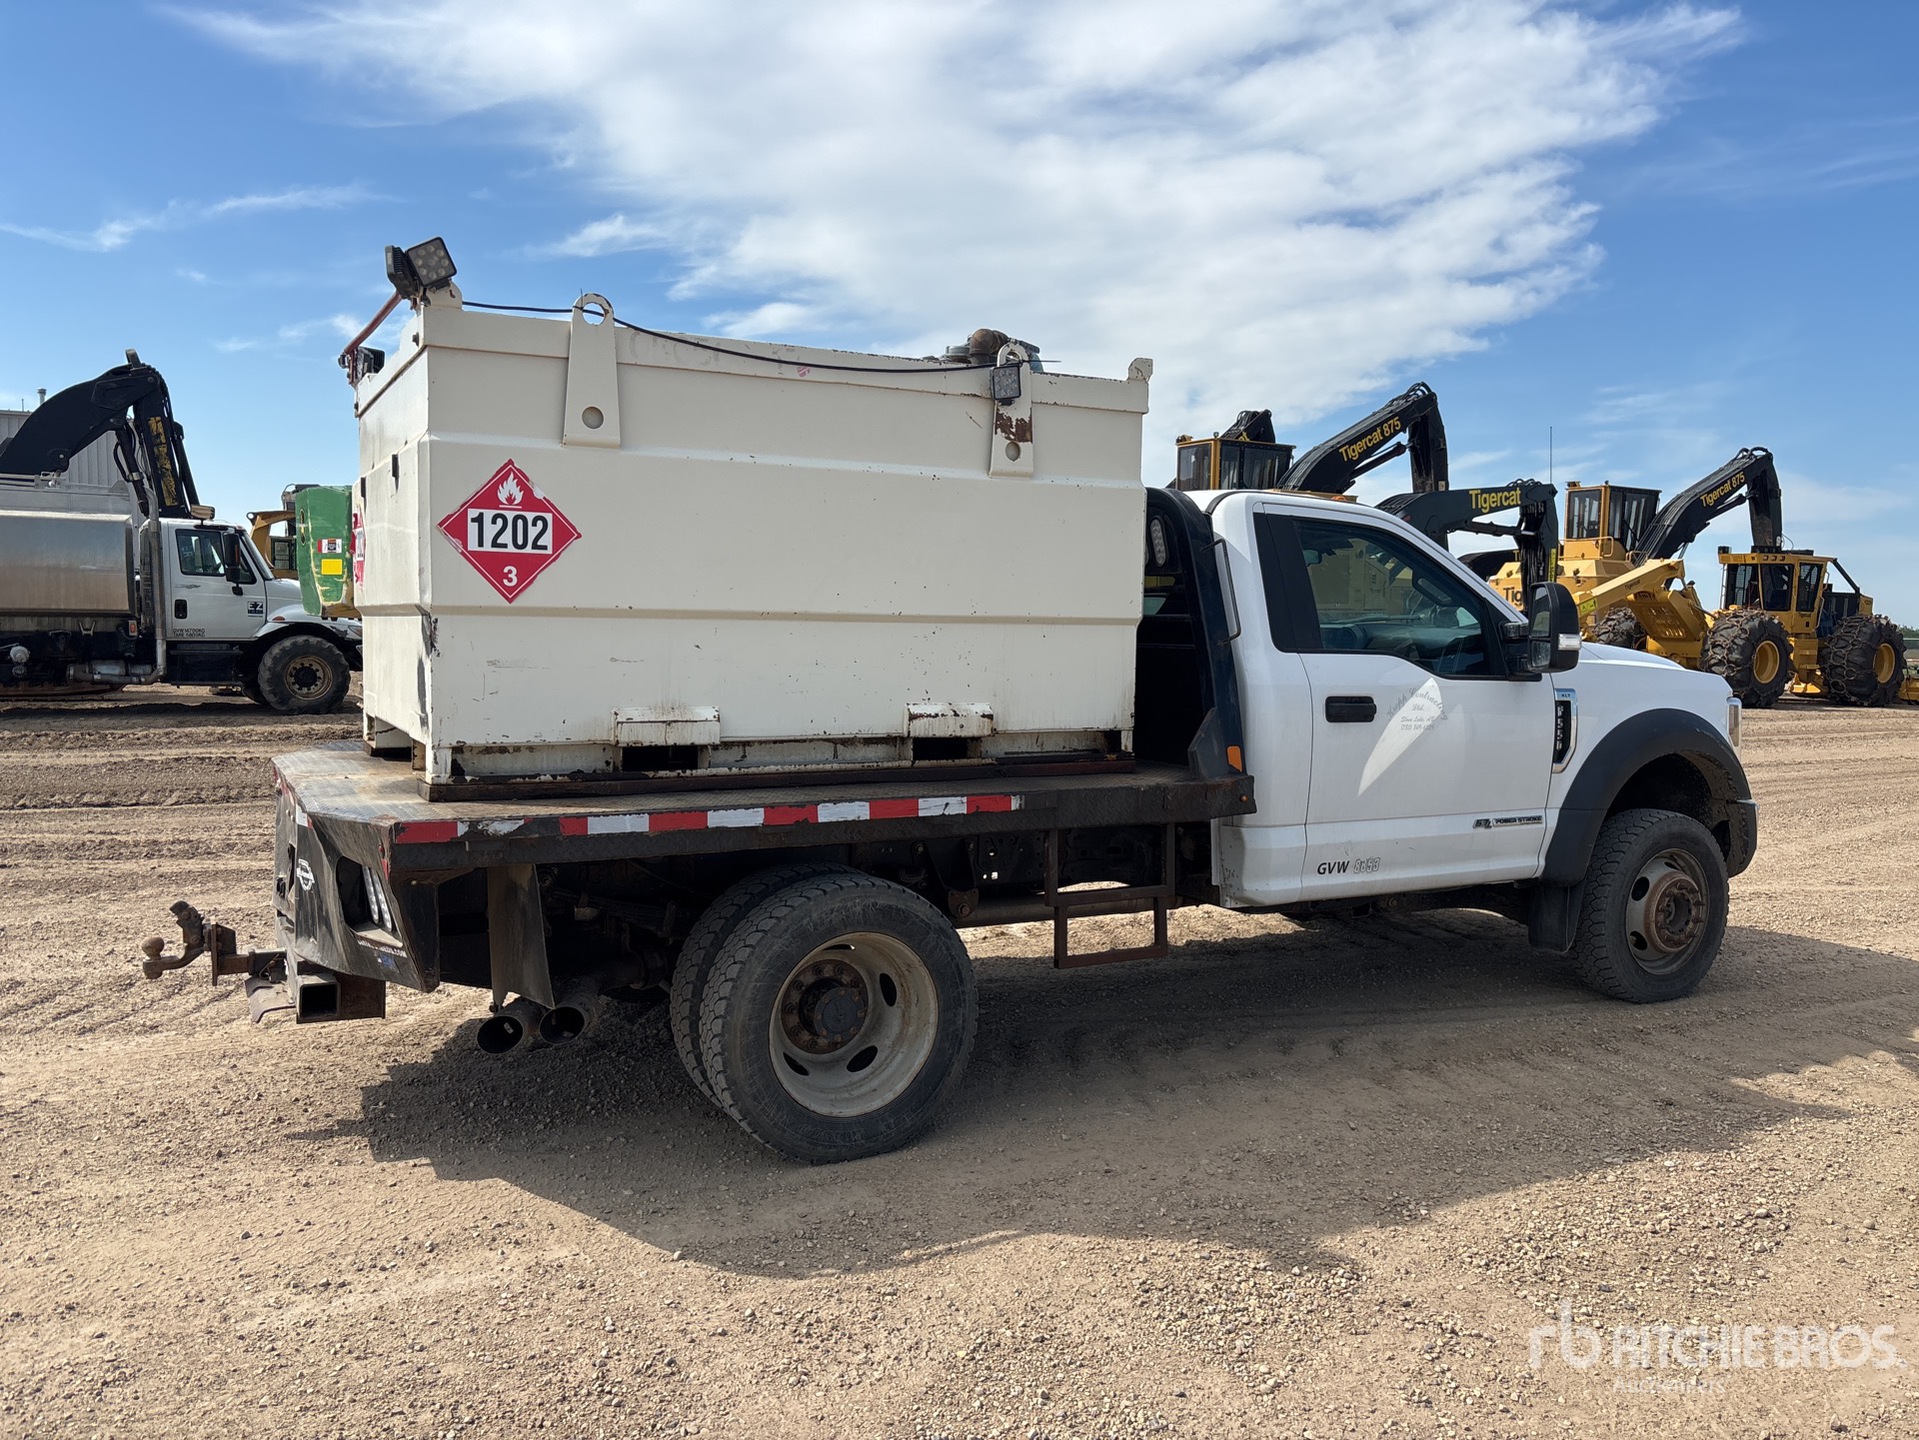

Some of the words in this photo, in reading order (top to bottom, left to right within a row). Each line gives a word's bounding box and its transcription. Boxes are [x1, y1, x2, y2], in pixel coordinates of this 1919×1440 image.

[1339, 427, 1383, 461] Tigercat
[1383, 417, 1401, 437] 875
[1469, 488, 1521, 513] Tigercat
[1700, 480, 1731, 507] Tigercat
[1732, 471, 1745, 488] 875
[470, 512, 549, 550] 1202
[503, 565, 518, 587] 3
[1317, 860, 1350, 875] GVW
